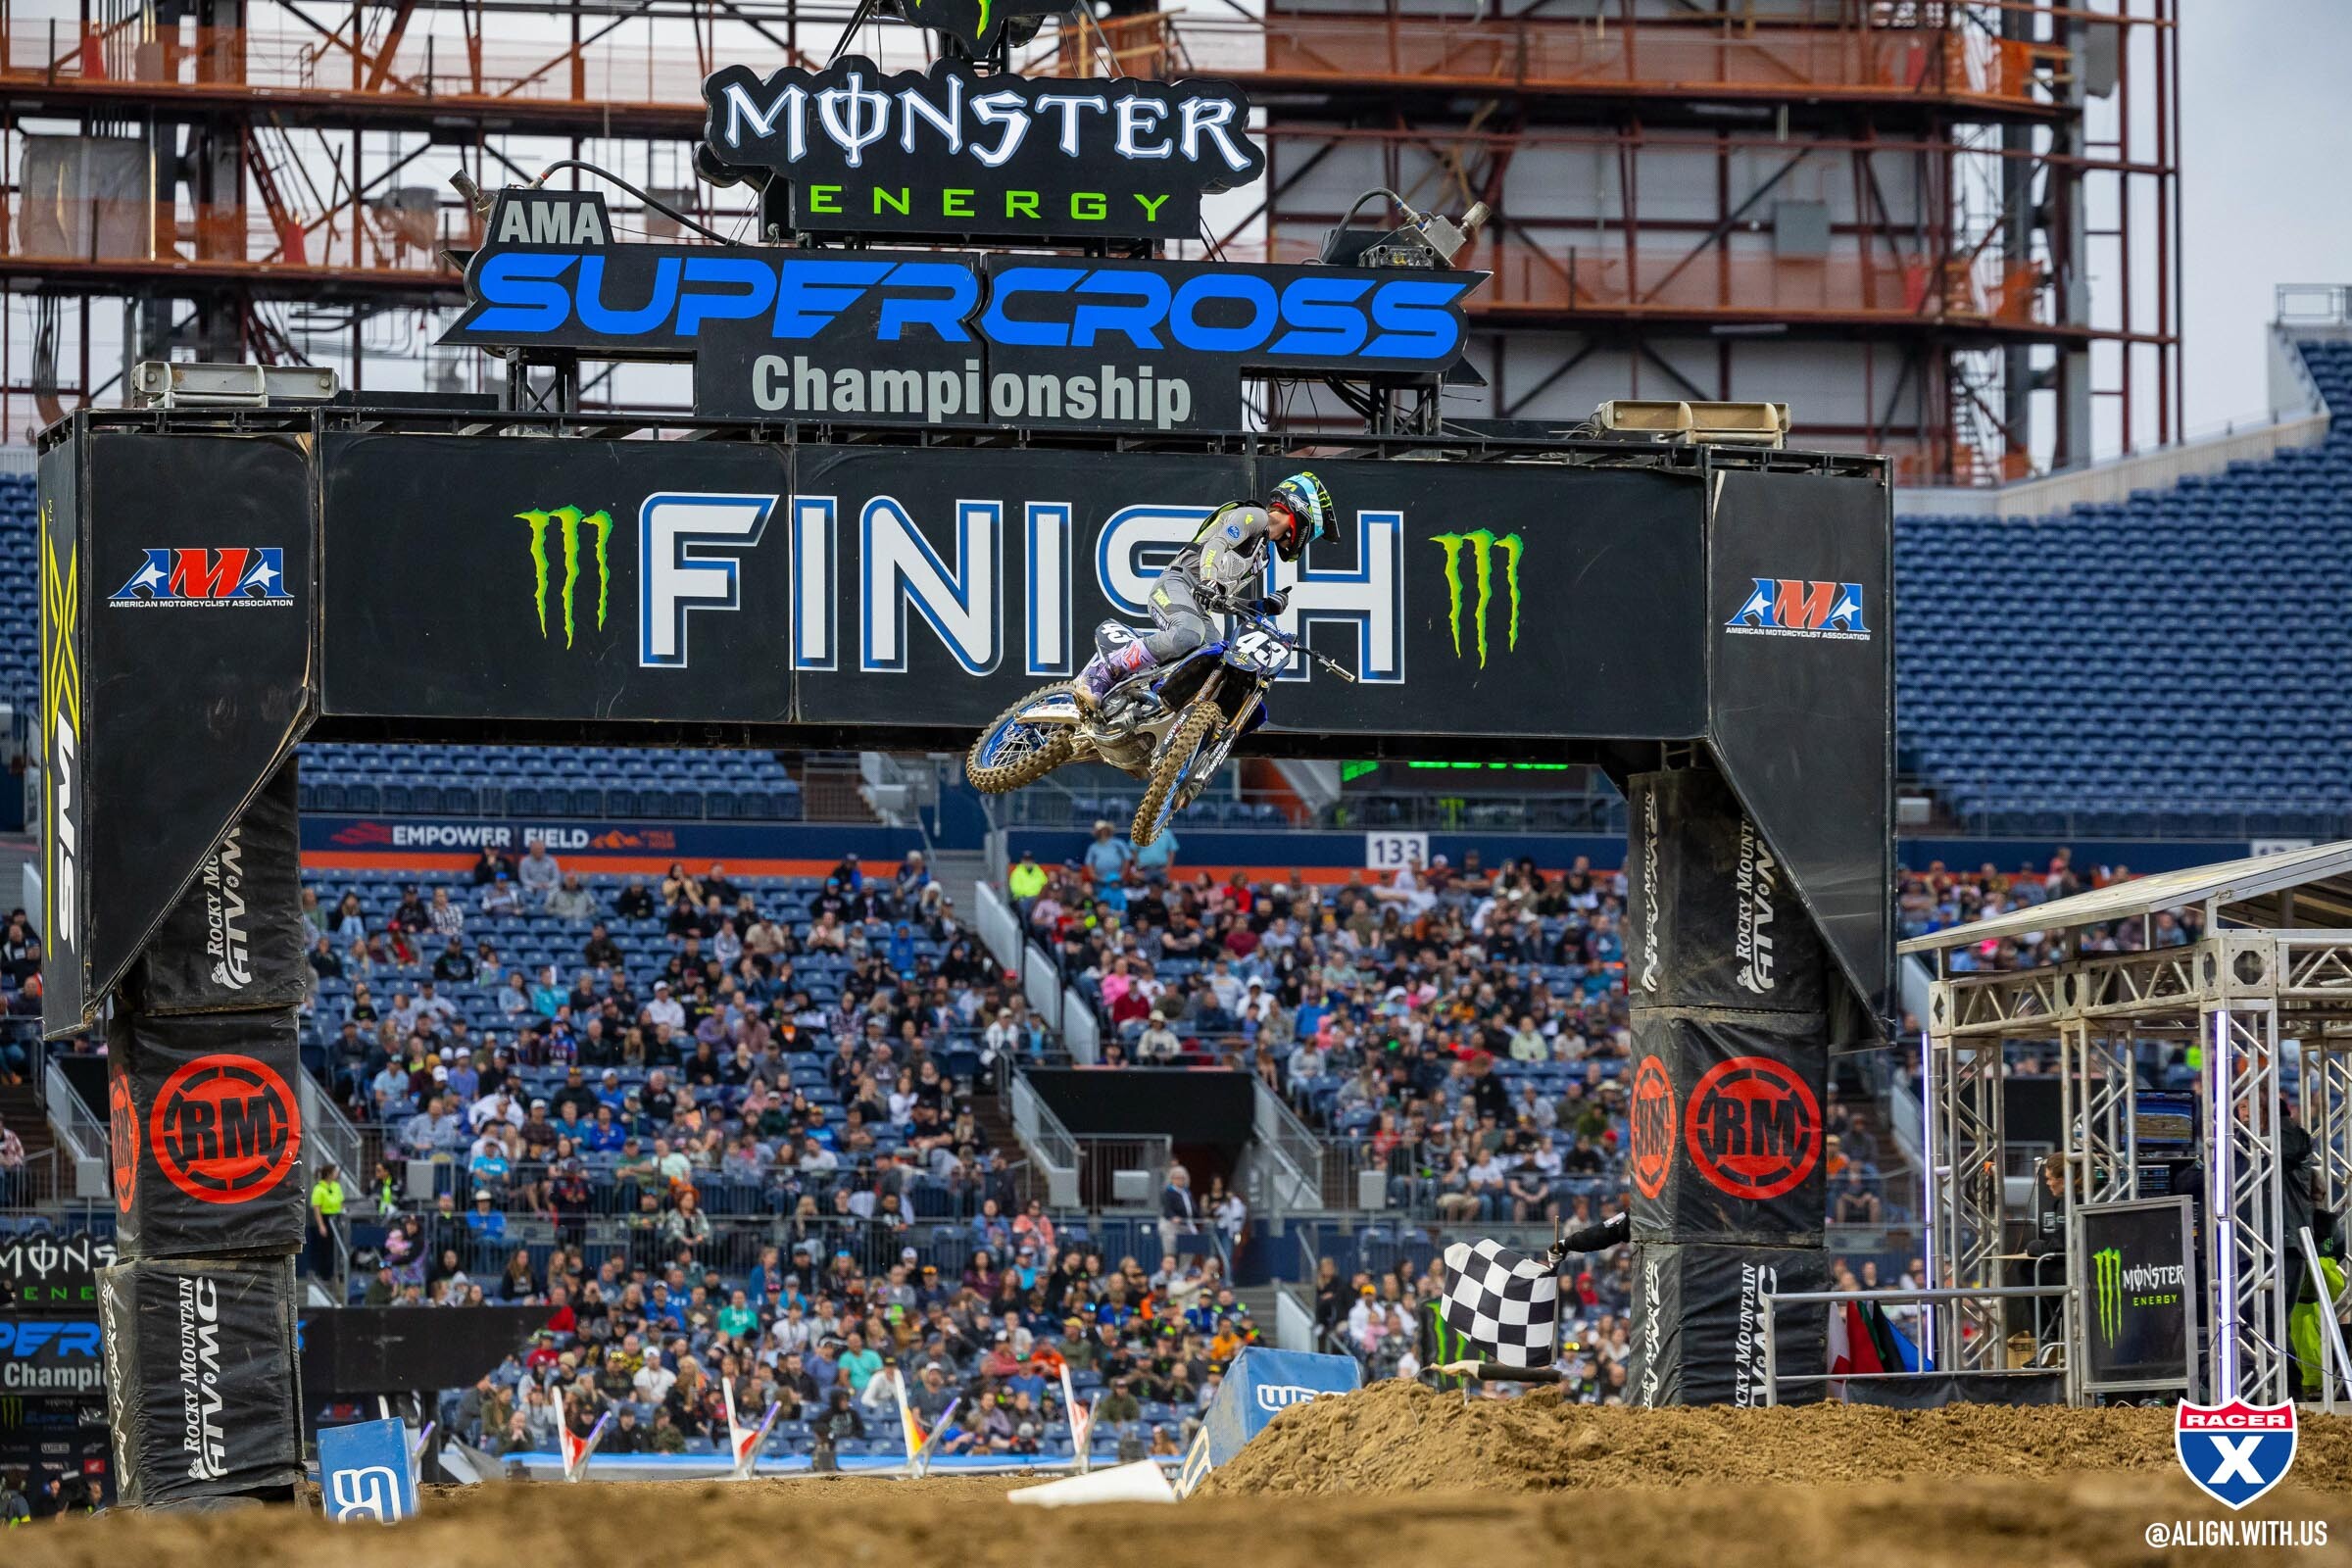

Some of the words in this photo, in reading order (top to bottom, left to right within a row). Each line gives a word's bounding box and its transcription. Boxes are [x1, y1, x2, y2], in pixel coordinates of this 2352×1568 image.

[721, 72, 1253, 172] MONSTER
[498, 201, 604, 245] AMA
[810, 184, 1170, 222] ENERGY
[466, 252, 1467, 360] SUPERCROSS
[752, 355, 1191, 429] Championship
[107, 547, 295, 600] AMA
[109, 600, 158, 609] AMERICAN
[231, 599, 294, 608] ASSOCIATION
[1723, 577, 1872, 633] AMA
[1235, 630, 1289, 668] 43
[1725, 626, 1765, 636] AMERICAN
[1765, 628, 1821, 639] MOTORCYCLIST
[1821, 631, 1871, 641] ASSOCIATION
[1208, 738, 1232, 773] DUNLOP
[392, 825, 511, 848] EMPOWER
[523, 828, 590, 850] FIELD
[1374, 839, 1422, 863] 133
[207, 892, 223, 958] ROCKY
[1736, 898, 1753, 961] ROCKY
[179, 1097, 272, 1161] RM
[1714, 1097, 1794, 1156] RM
[2123, 1263, 2185, 1293] MONSTER
[2132, 1294, 2178, 1307] ENERGY
[178, 1275, 198, 1387] MOUNTAIN
[1736, 1262, 1756, 1369] MOUNTAIN
[183, 1388, 201, 1454] ROCKY
